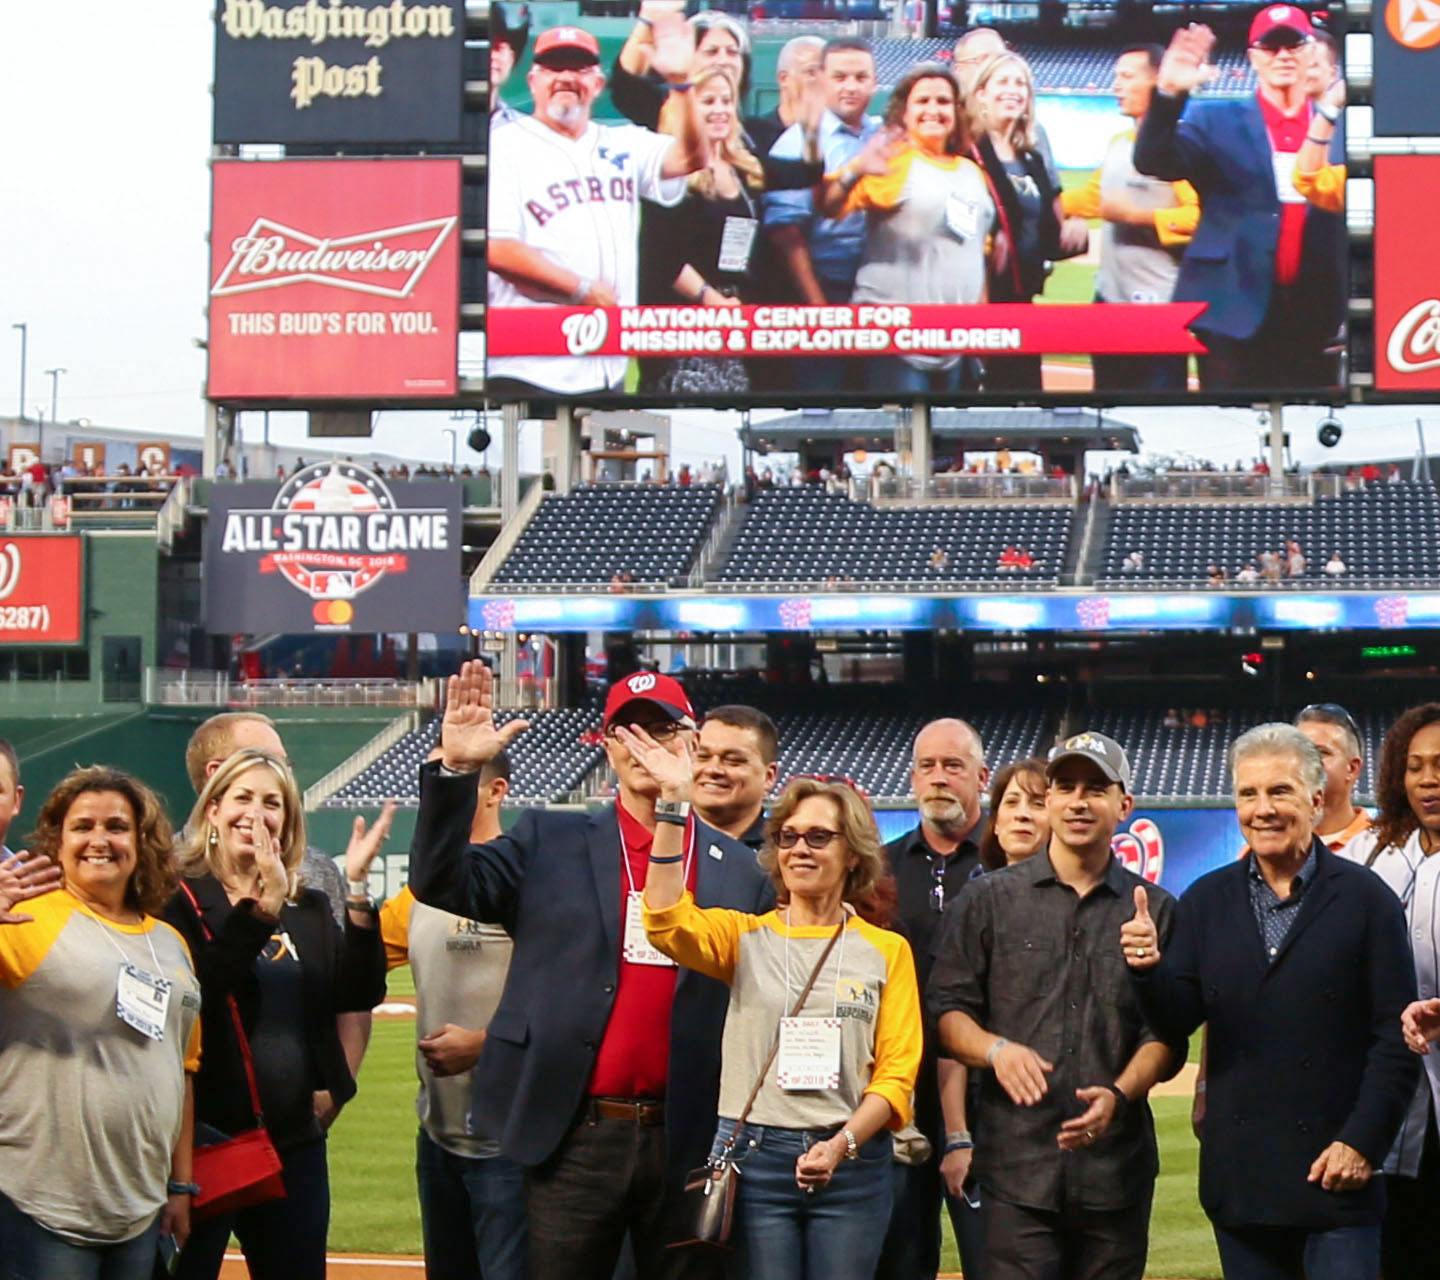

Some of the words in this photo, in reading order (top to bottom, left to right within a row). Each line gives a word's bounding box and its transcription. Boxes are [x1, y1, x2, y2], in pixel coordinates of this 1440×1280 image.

[291, 55, 383, 109] Post
[231, 236, 428, 273] Budweiser
[229, 313, 277, 335] THIS
[279, 312, 340, 335] BUD'S
[346, 312, 386, 334] FOR
[390, 312, 438, 334] YOU.
[620, 307, 747, 328] NATIONAL
[754, 307, 853, 327] CENTER
[859, 306, 910, 326] FOR
[620, 330, 723, 351] MISSING
[727, 330, 746, 350] &
[751, 329, 890, 350] EXPLOITED
[895, 328, 1020, 349] CHILDREN
[222, 514, 278, 552] ALL
[283, 514, 360, 551] STAR
[367, 514, 449, 550] GAME
